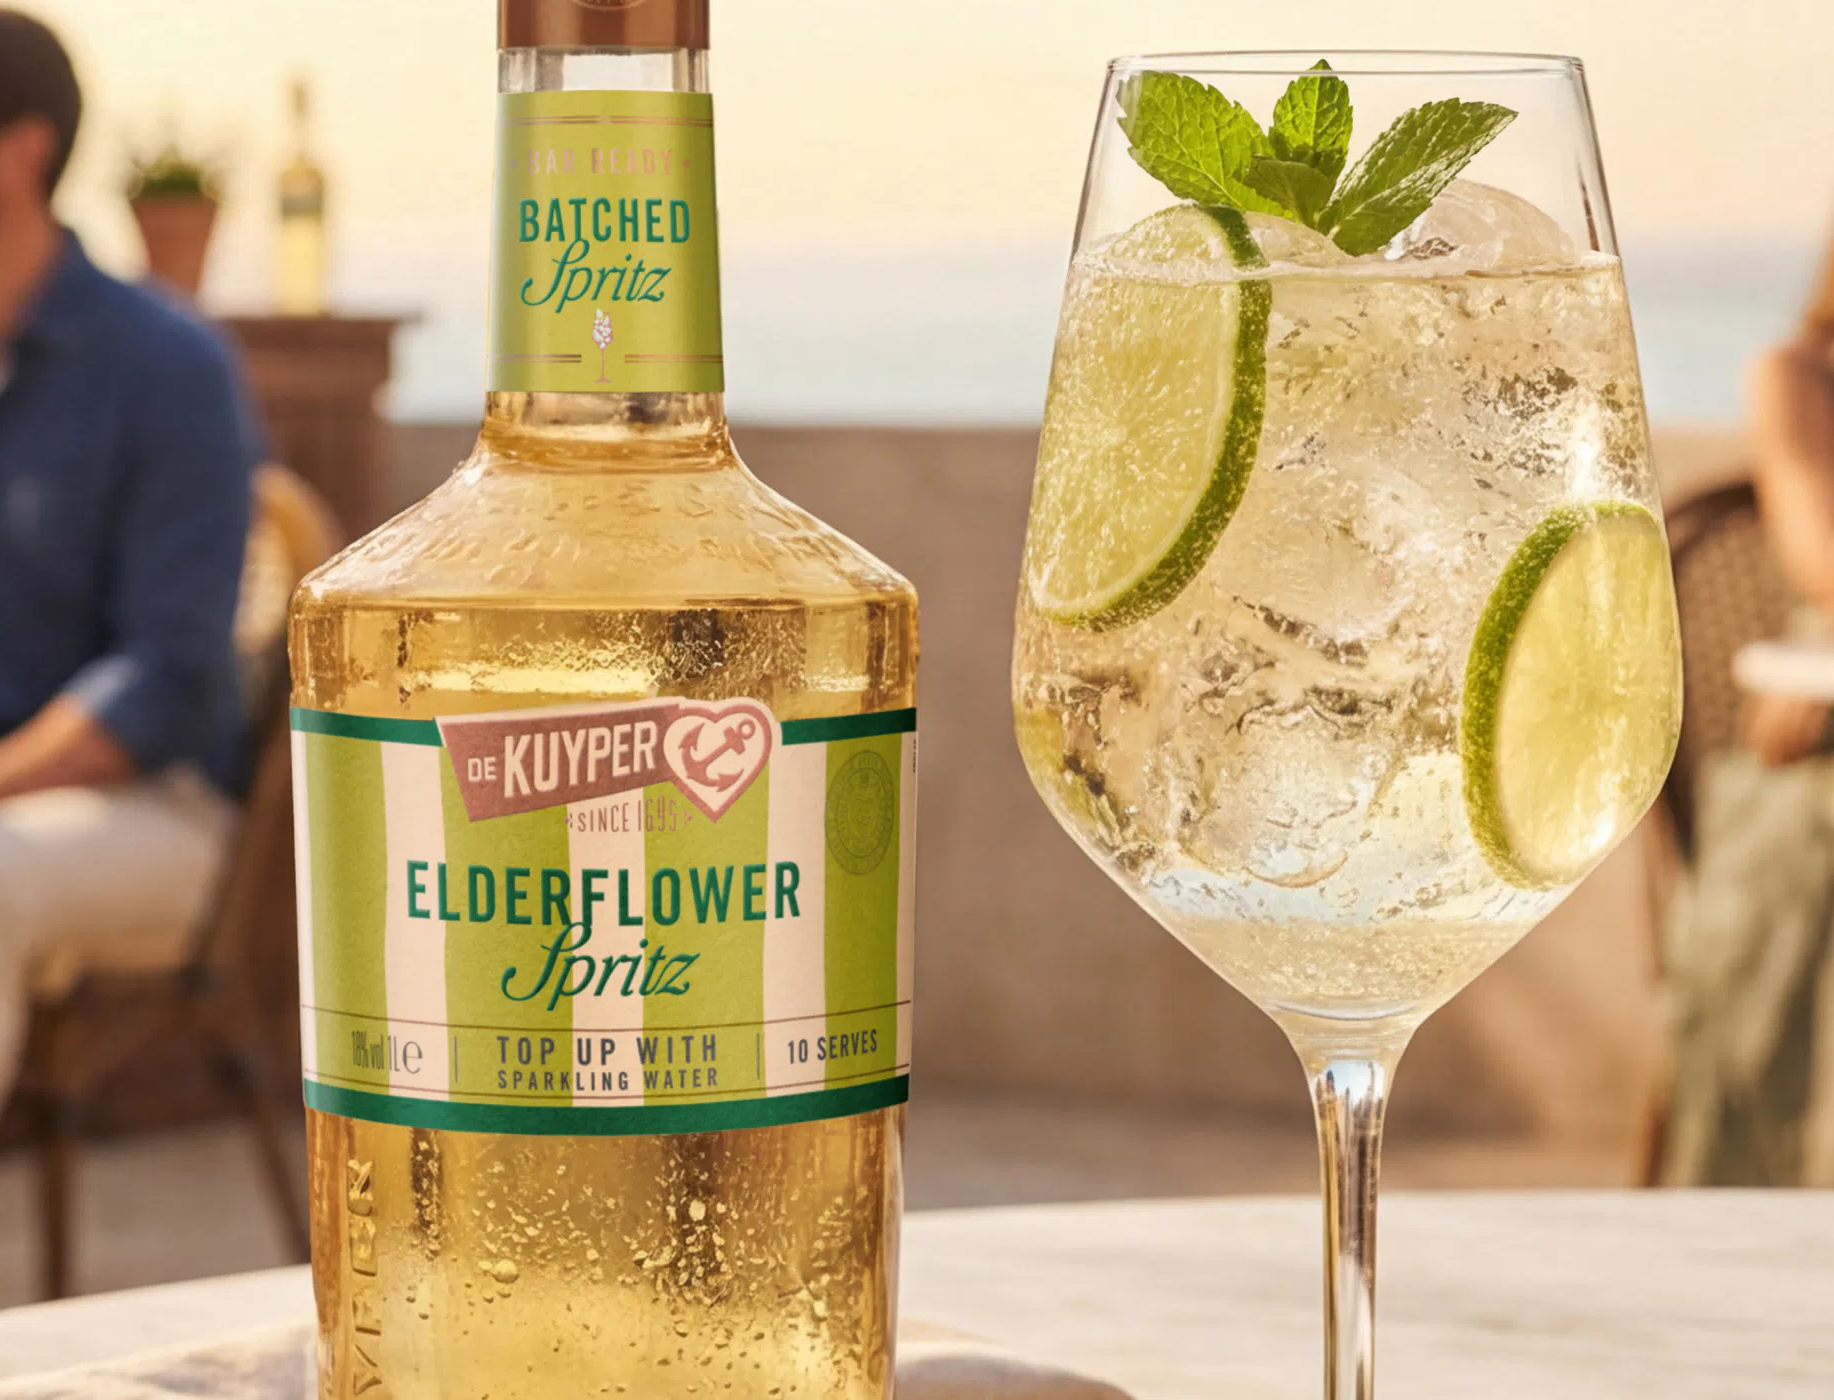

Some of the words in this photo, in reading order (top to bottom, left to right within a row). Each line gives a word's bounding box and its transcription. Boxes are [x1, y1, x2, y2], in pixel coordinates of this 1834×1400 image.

[527, 148, 576, 175] BAR
[591, 148, 673, 176] READY
[518, 197, 691, 244] BATCHED
[520, 238, 672, 313] Spritz
[468, 756, 497, 782] DE
[504, 720, 659, 799] KUYPER
[577, 802, 630, 833] SINCE
[637, 795, 678, 833] 1695
[407, 860, 801, 927] ELDERFLOWER
[500, 922, 701, 1012] Spritz
[496, 1036, 555, 1066] TOP
[577, 1037, 616, 1066] UP
[636, 1033, 717, 1065] WITH
[787, 1038, 808, 1065] 10
[816, 1028, 878, 1061] SERVES
[497, 1069, 629, 1092] SPARKLING
[643, 1066, 719, 1090] WATER
